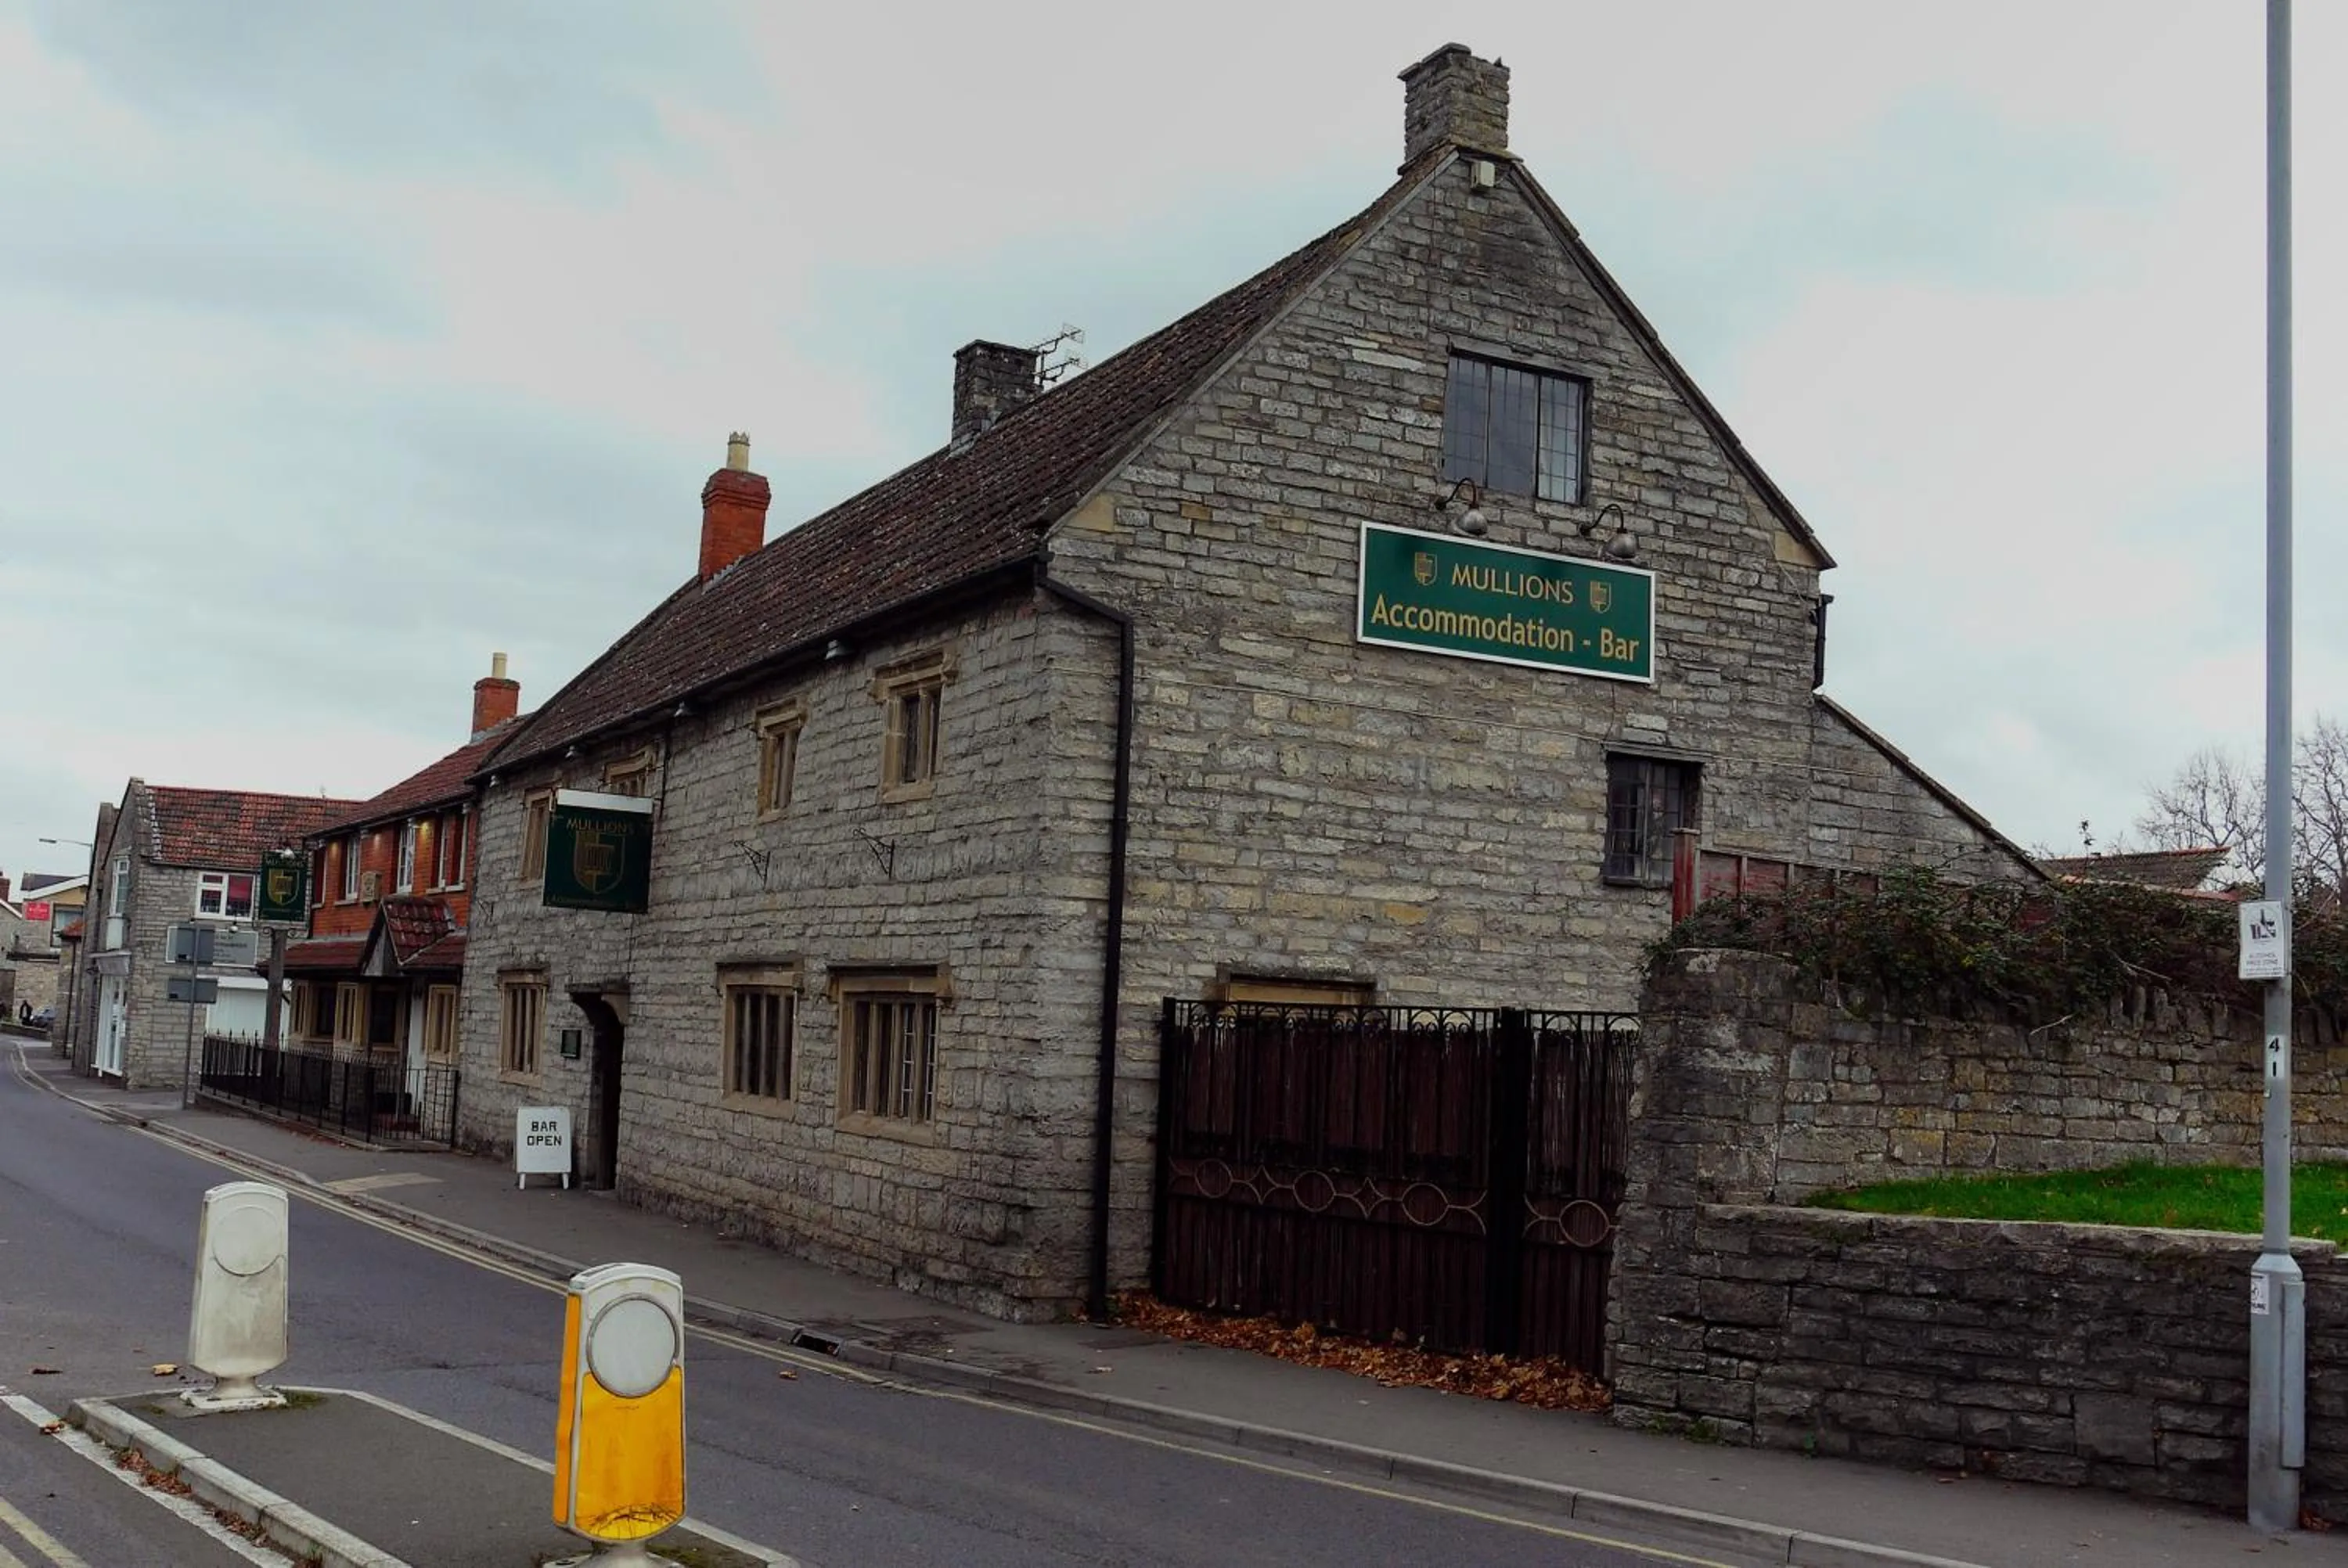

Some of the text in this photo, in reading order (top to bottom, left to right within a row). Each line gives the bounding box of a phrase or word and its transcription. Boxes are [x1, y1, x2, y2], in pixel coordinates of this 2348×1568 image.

[1451, 563, 1574, 604] MULLIONS
[1370, 594, 1575, 653] Accommodation
[1599, 626, 1640, 663] Bar
[531, 1121, 557, 1132] BAR
[527, 1135, 562, 1146] OPEN
